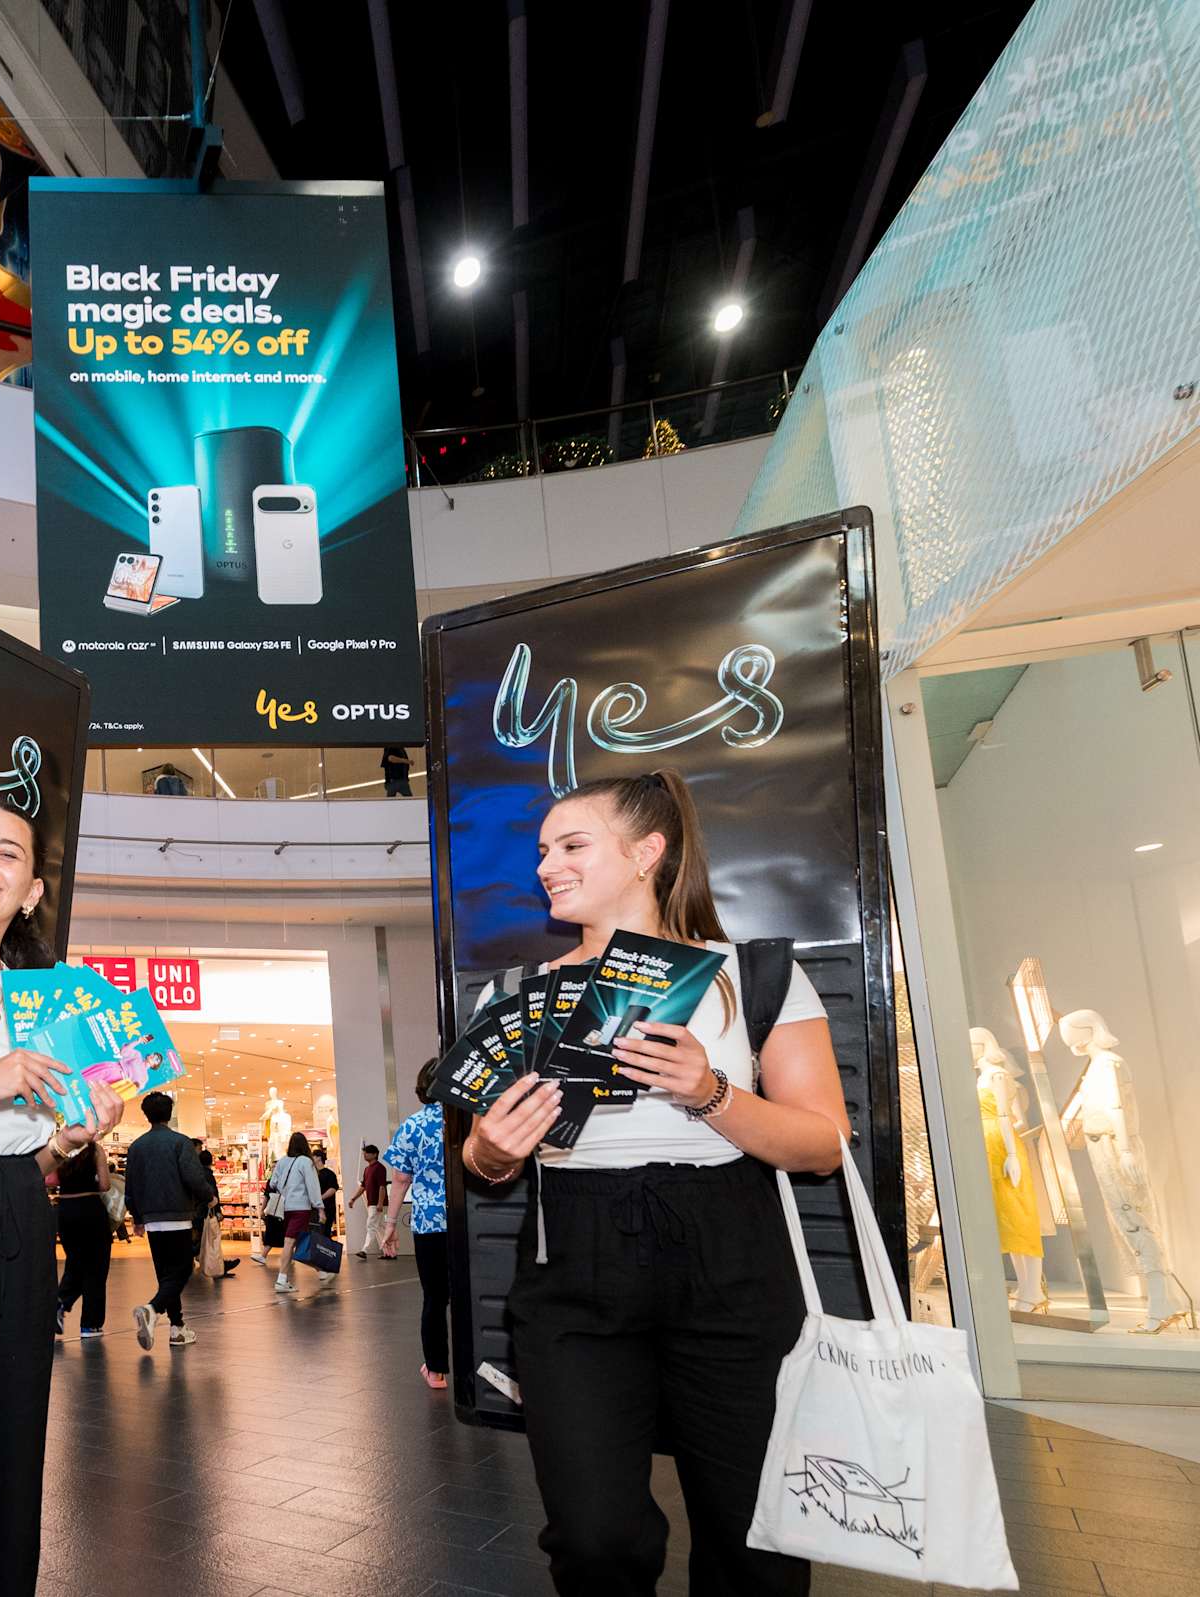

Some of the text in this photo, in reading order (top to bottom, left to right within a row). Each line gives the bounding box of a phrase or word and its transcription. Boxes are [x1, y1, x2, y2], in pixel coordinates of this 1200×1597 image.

[66, 264, 280, 299] Black Friday
[67, 296, 283, 330] magic deals.
[68, 327, 311, 361] Up to 54% off
[69, 369, 327, 384] on mobile, home internet and more.
[216, 560, 248, 570] OPTUS
[78, 640, 125, 651] motorola
[127, 641, 149, 650] razr
[173, 640, 292, 652] SAMSUNG Galaxy S24 FE
[307, 639, 397, 652] Google Pixel 9 Pro
[255, 688, 410, 730] yes OPTUS
[103, 722, 123, 731] T&Cs
[123, 723, 145, 733] apply.
[492, 642, 784, 800] yes
[609, 947, 674, 972] Black Friday
[600, 966, 616, 979] Up
[615, 970, 629, 981] to
[652, 979, 673, 990] off
[604, 959, 668, 980] magic deals.
[555, 1000, 571, 1012] Up
[505, 1029, 522, 1041] Up
[451, 1057, 476, 1082] Black
[468, 1077, 485, 1091] Up
